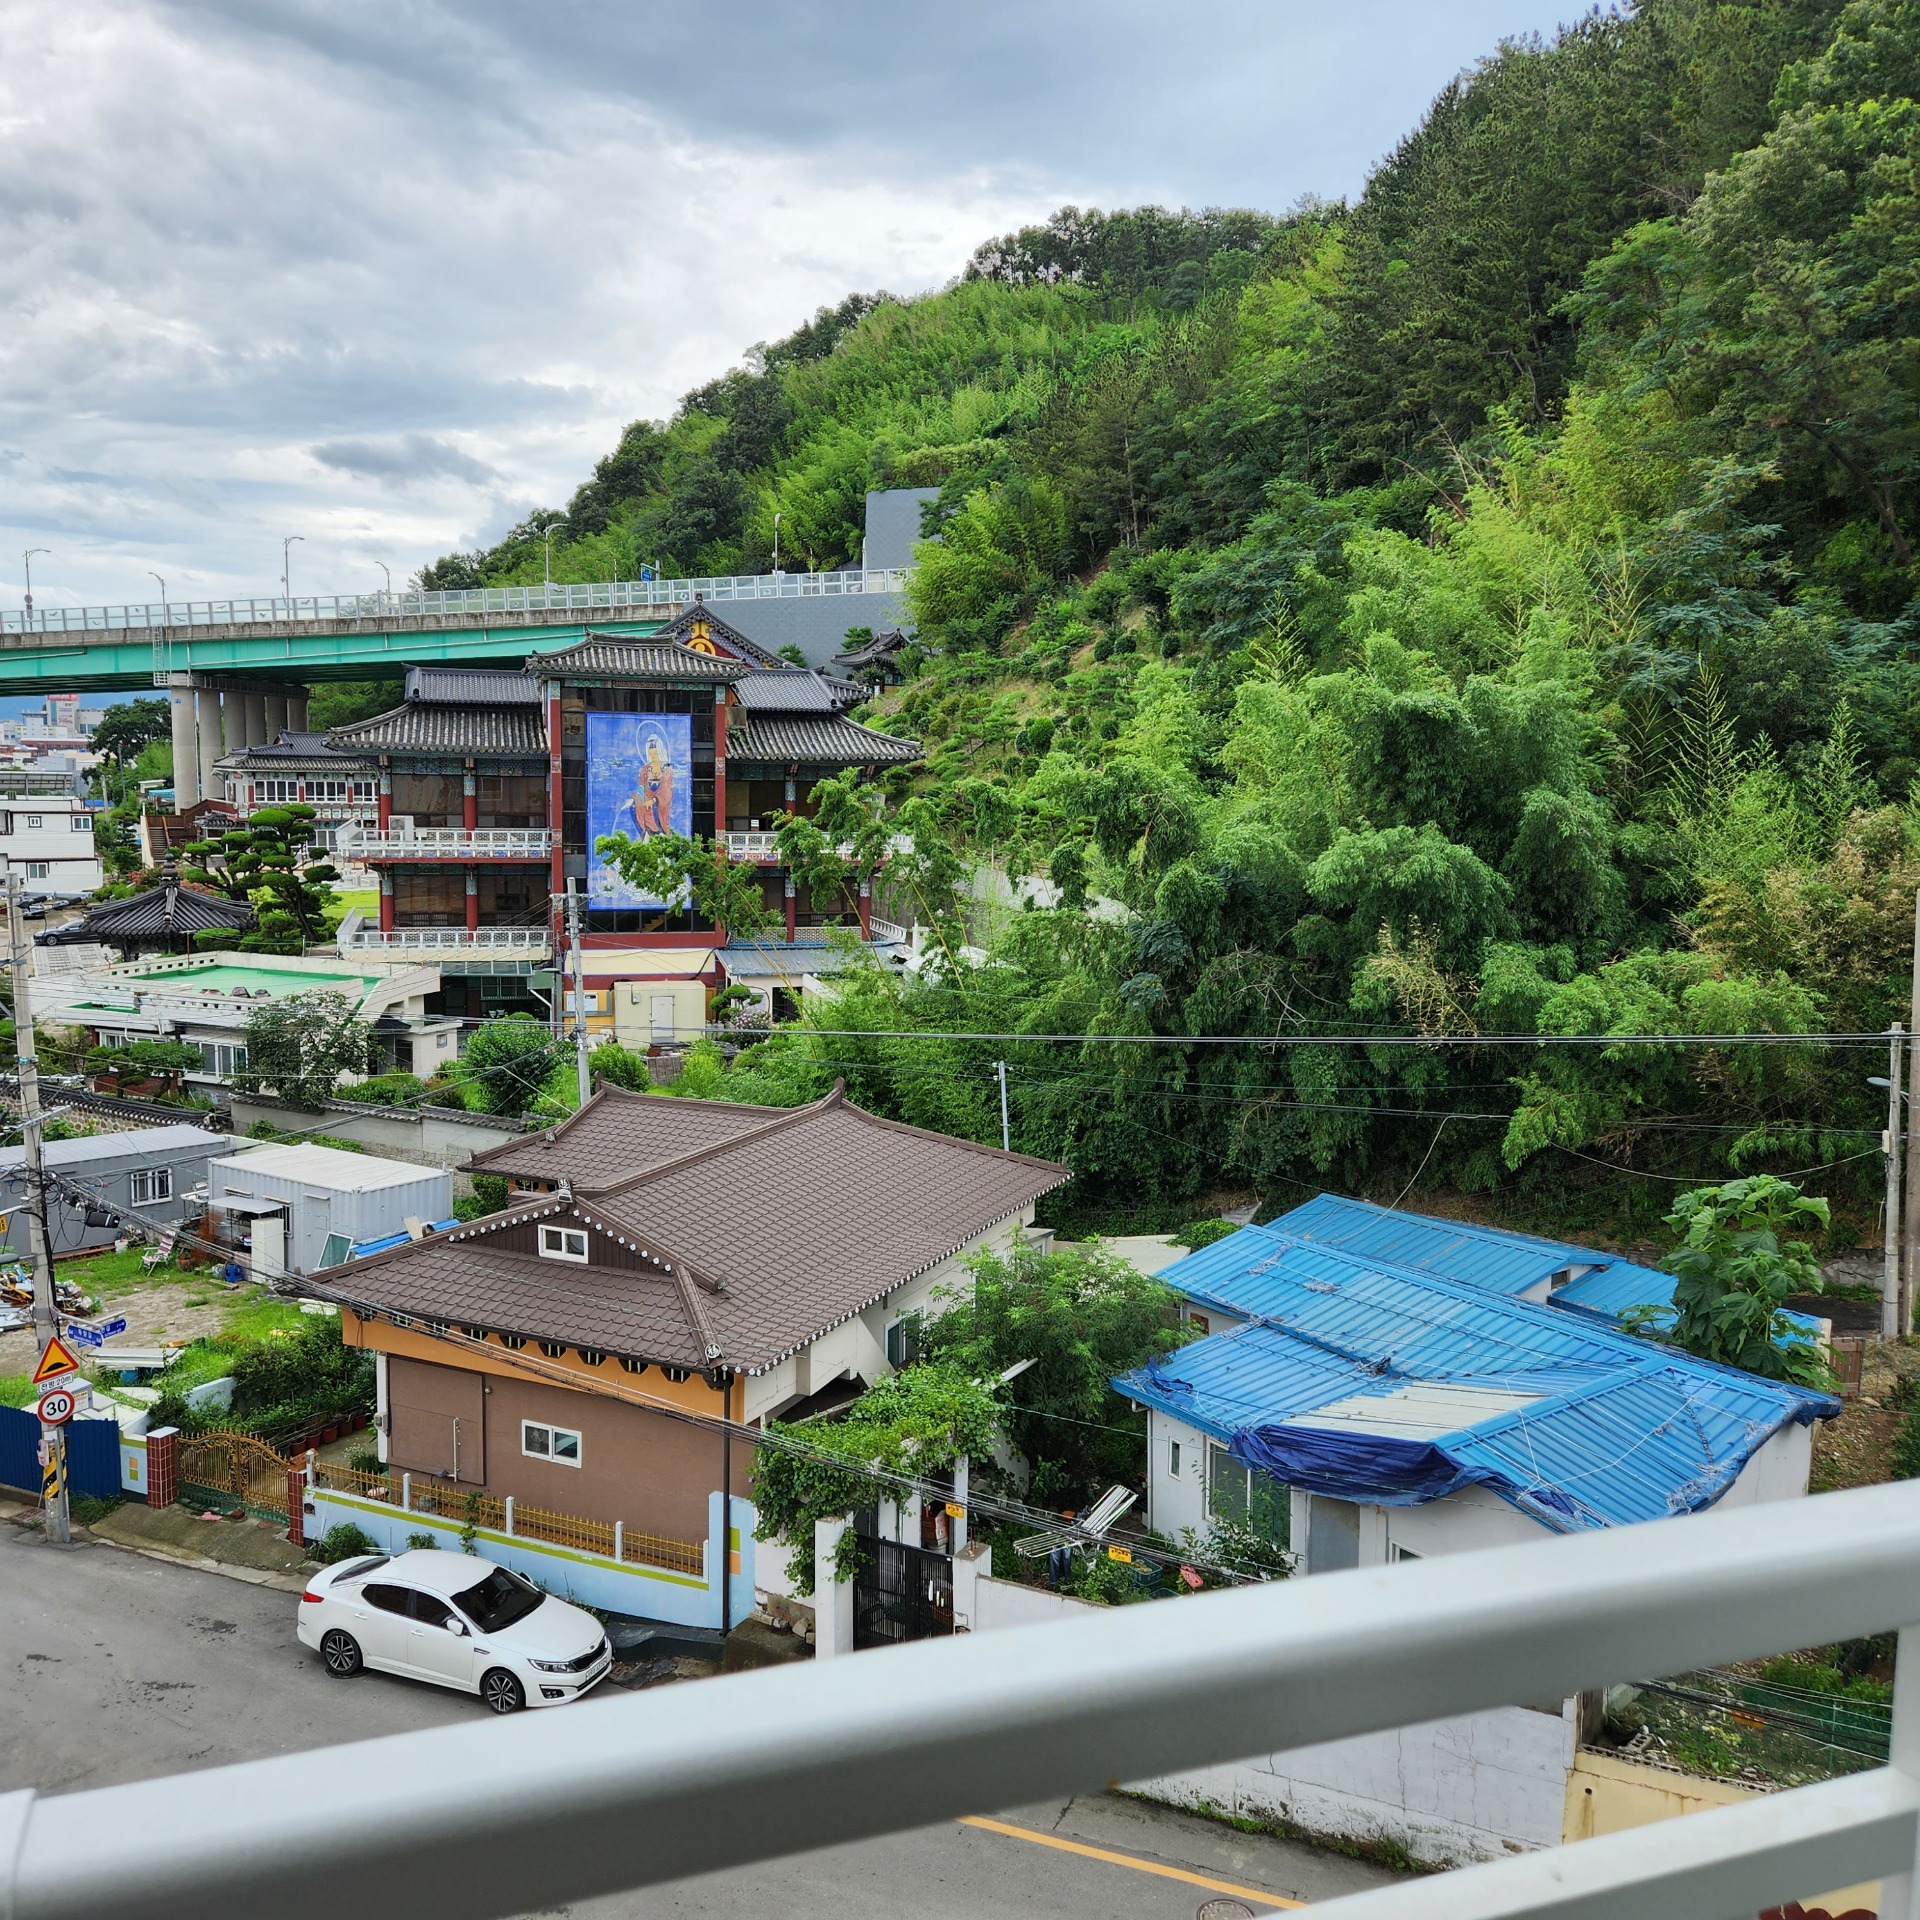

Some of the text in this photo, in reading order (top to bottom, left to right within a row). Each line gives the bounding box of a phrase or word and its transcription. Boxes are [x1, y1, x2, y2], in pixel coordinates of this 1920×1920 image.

[41, 1376, 71, 1391] 전방 20m
[46, 1398, 67, 1416] 30
